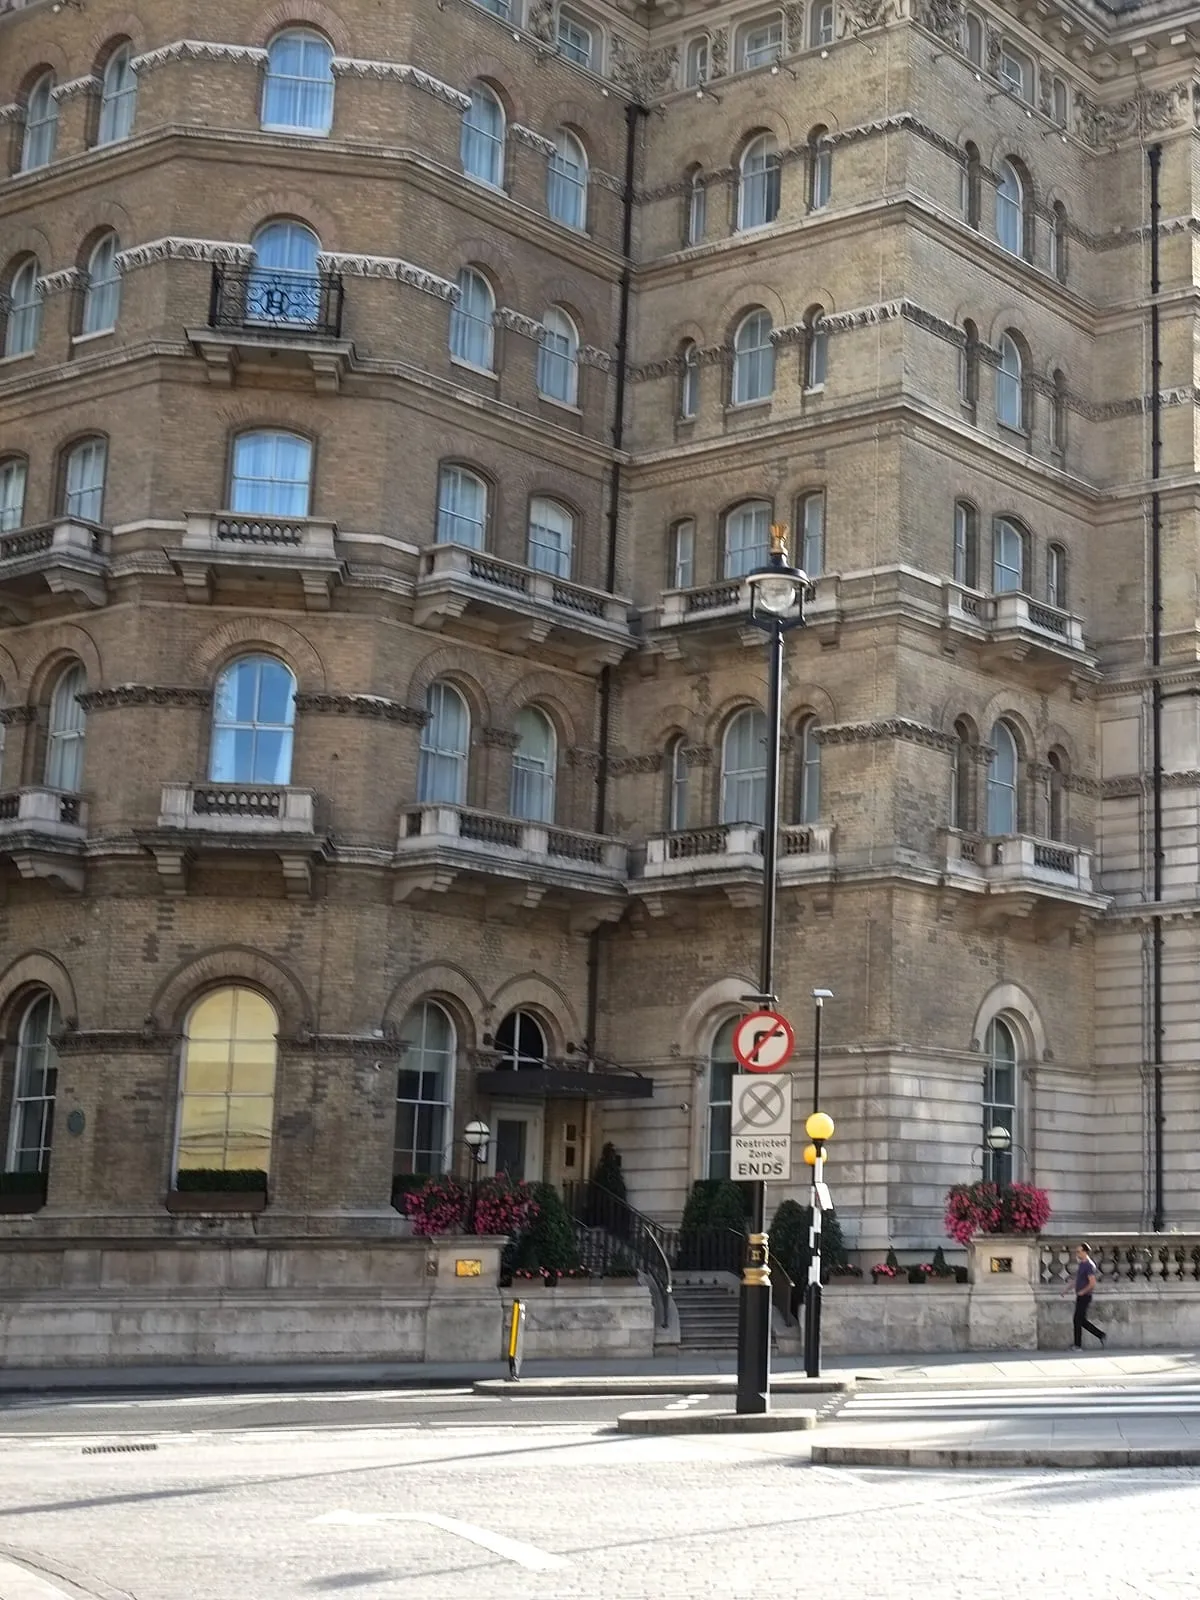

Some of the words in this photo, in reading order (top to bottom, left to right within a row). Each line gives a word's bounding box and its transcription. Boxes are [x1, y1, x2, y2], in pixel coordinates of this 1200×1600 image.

[736, 1139, 787, 1148] Restricted
[749, 1149, 772, 1158] Zone
[738, 1163, 783, 1175] ENDS
